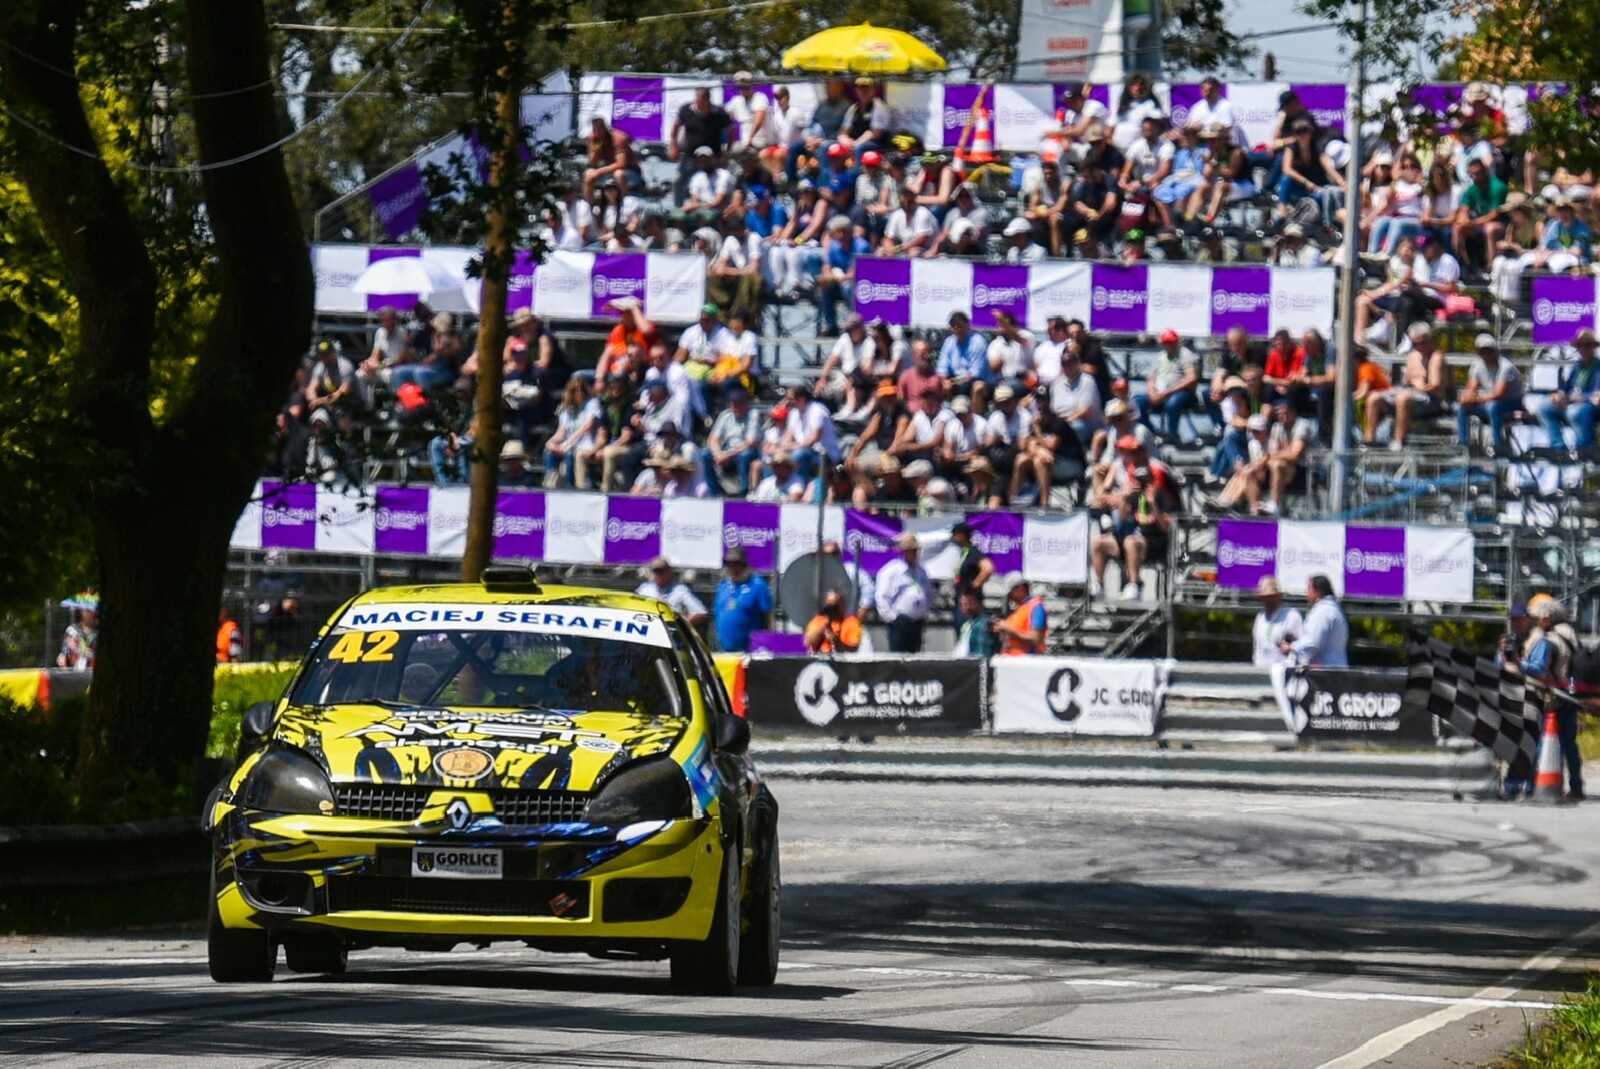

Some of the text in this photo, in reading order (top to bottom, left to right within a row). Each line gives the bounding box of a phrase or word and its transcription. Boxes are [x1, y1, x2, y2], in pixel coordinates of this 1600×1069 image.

[352, 609, 650, 637] MACIEJ SERAFIN
[327, 630, 401, 664] 42
[842, 680, 944, 706] JC GROUP
[1090, 687, 1109, 705] JC
[1310, 690, 1402, 718] JC GROUP
[436, 852, 498, 867] GORLICE
